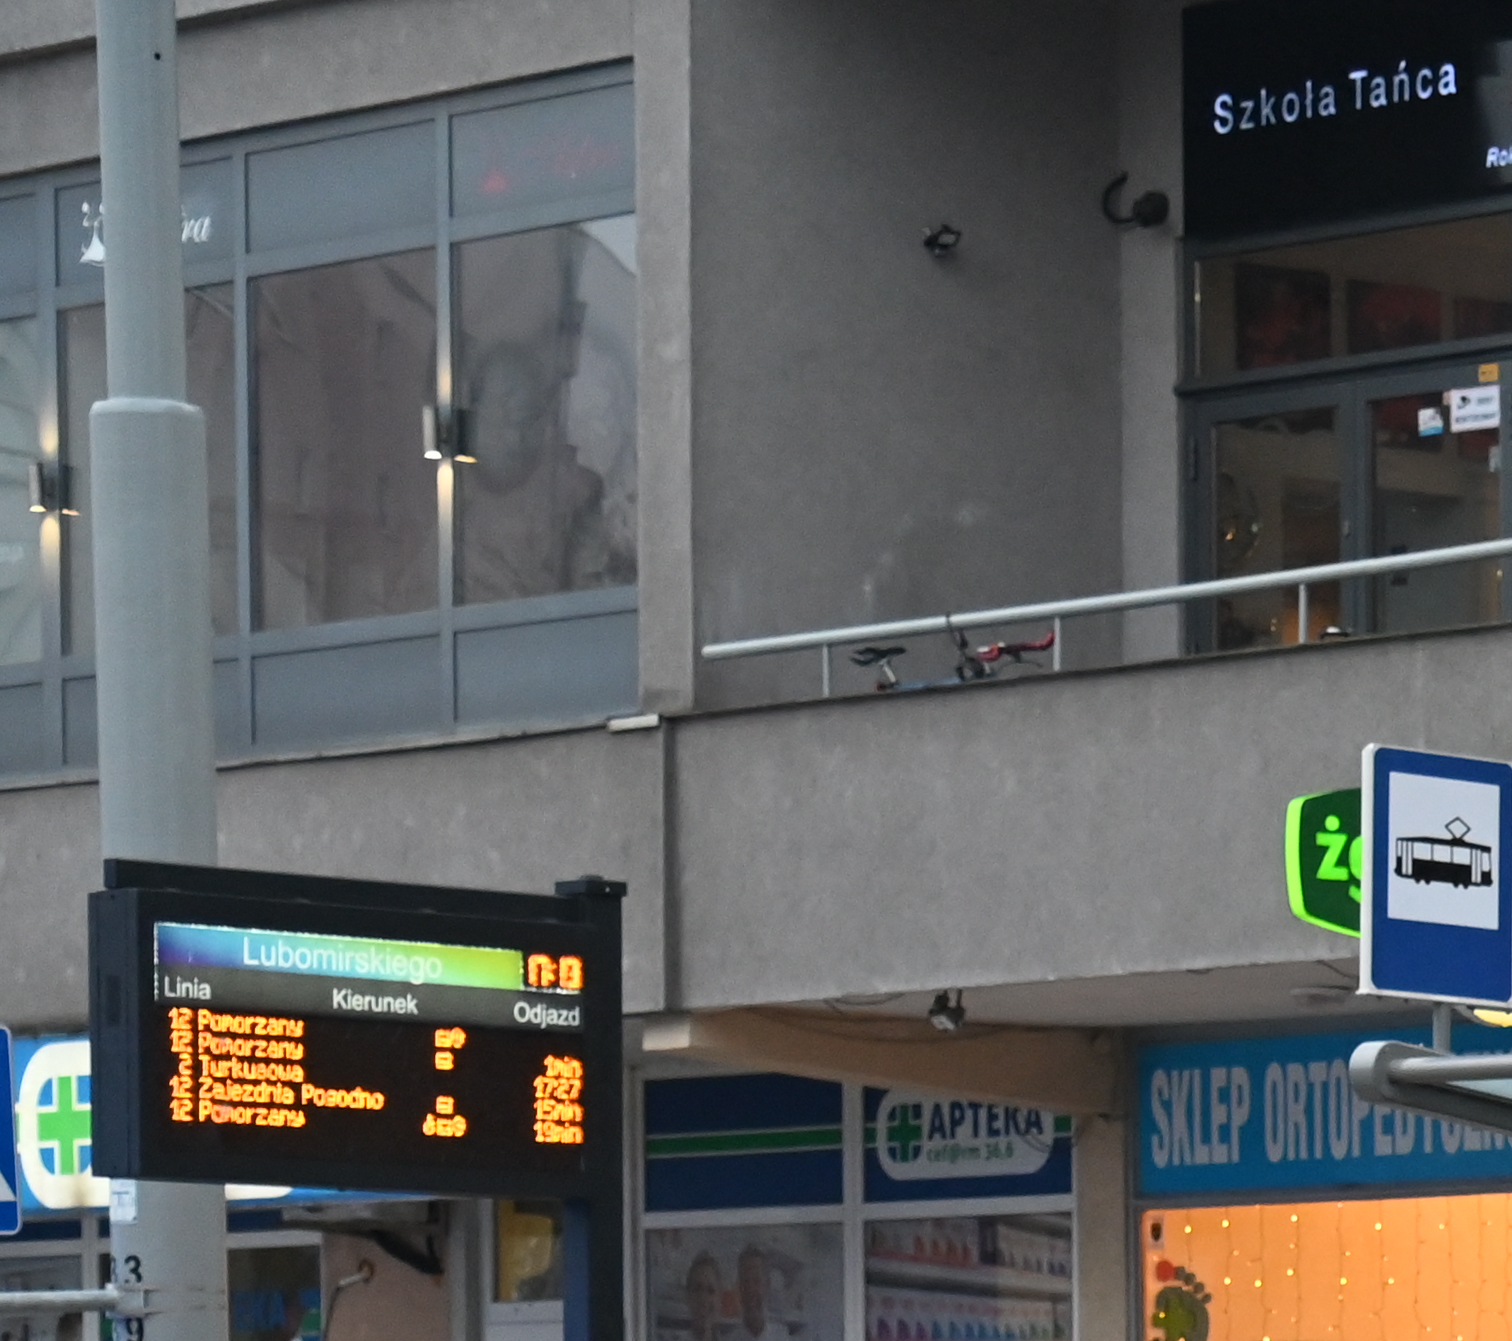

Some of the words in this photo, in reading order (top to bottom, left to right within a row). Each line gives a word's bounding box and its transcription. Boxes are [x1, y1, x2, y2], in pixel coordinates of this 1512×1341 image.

[1213, 79, 1337, 134] Szkoła
[1348, 59, 1457, 110] Tańca
[242, 936, 444, 985] Lubomirskiego
[164, 975, 212, 1000] Linia
[332, 987, 419, 1015] Kierunek
[513, 1000, 581, 1029] Odjazd
[168, 1007, 193, 1030] 12
[198, 1009, 304, 1038] Pomorzany
[169, 1030, 193, 1053] 12
[198, 1031, 304, 1060] Pomorzany
[168, 1074, 193, 1098] 12
[198, 1076, 295, 1105] Zajezdnia
[178, 1052, 193, 1075] 2
[533, 1075, 582, 1099] 17:27
[168, 1097, 193, 1122] 12
[198, 1099, 306, 1128] Pomorzany
[928, 1100, 1045, 1142] APTEKA
[1151, 1066, 1251, 1169] SKLEP
